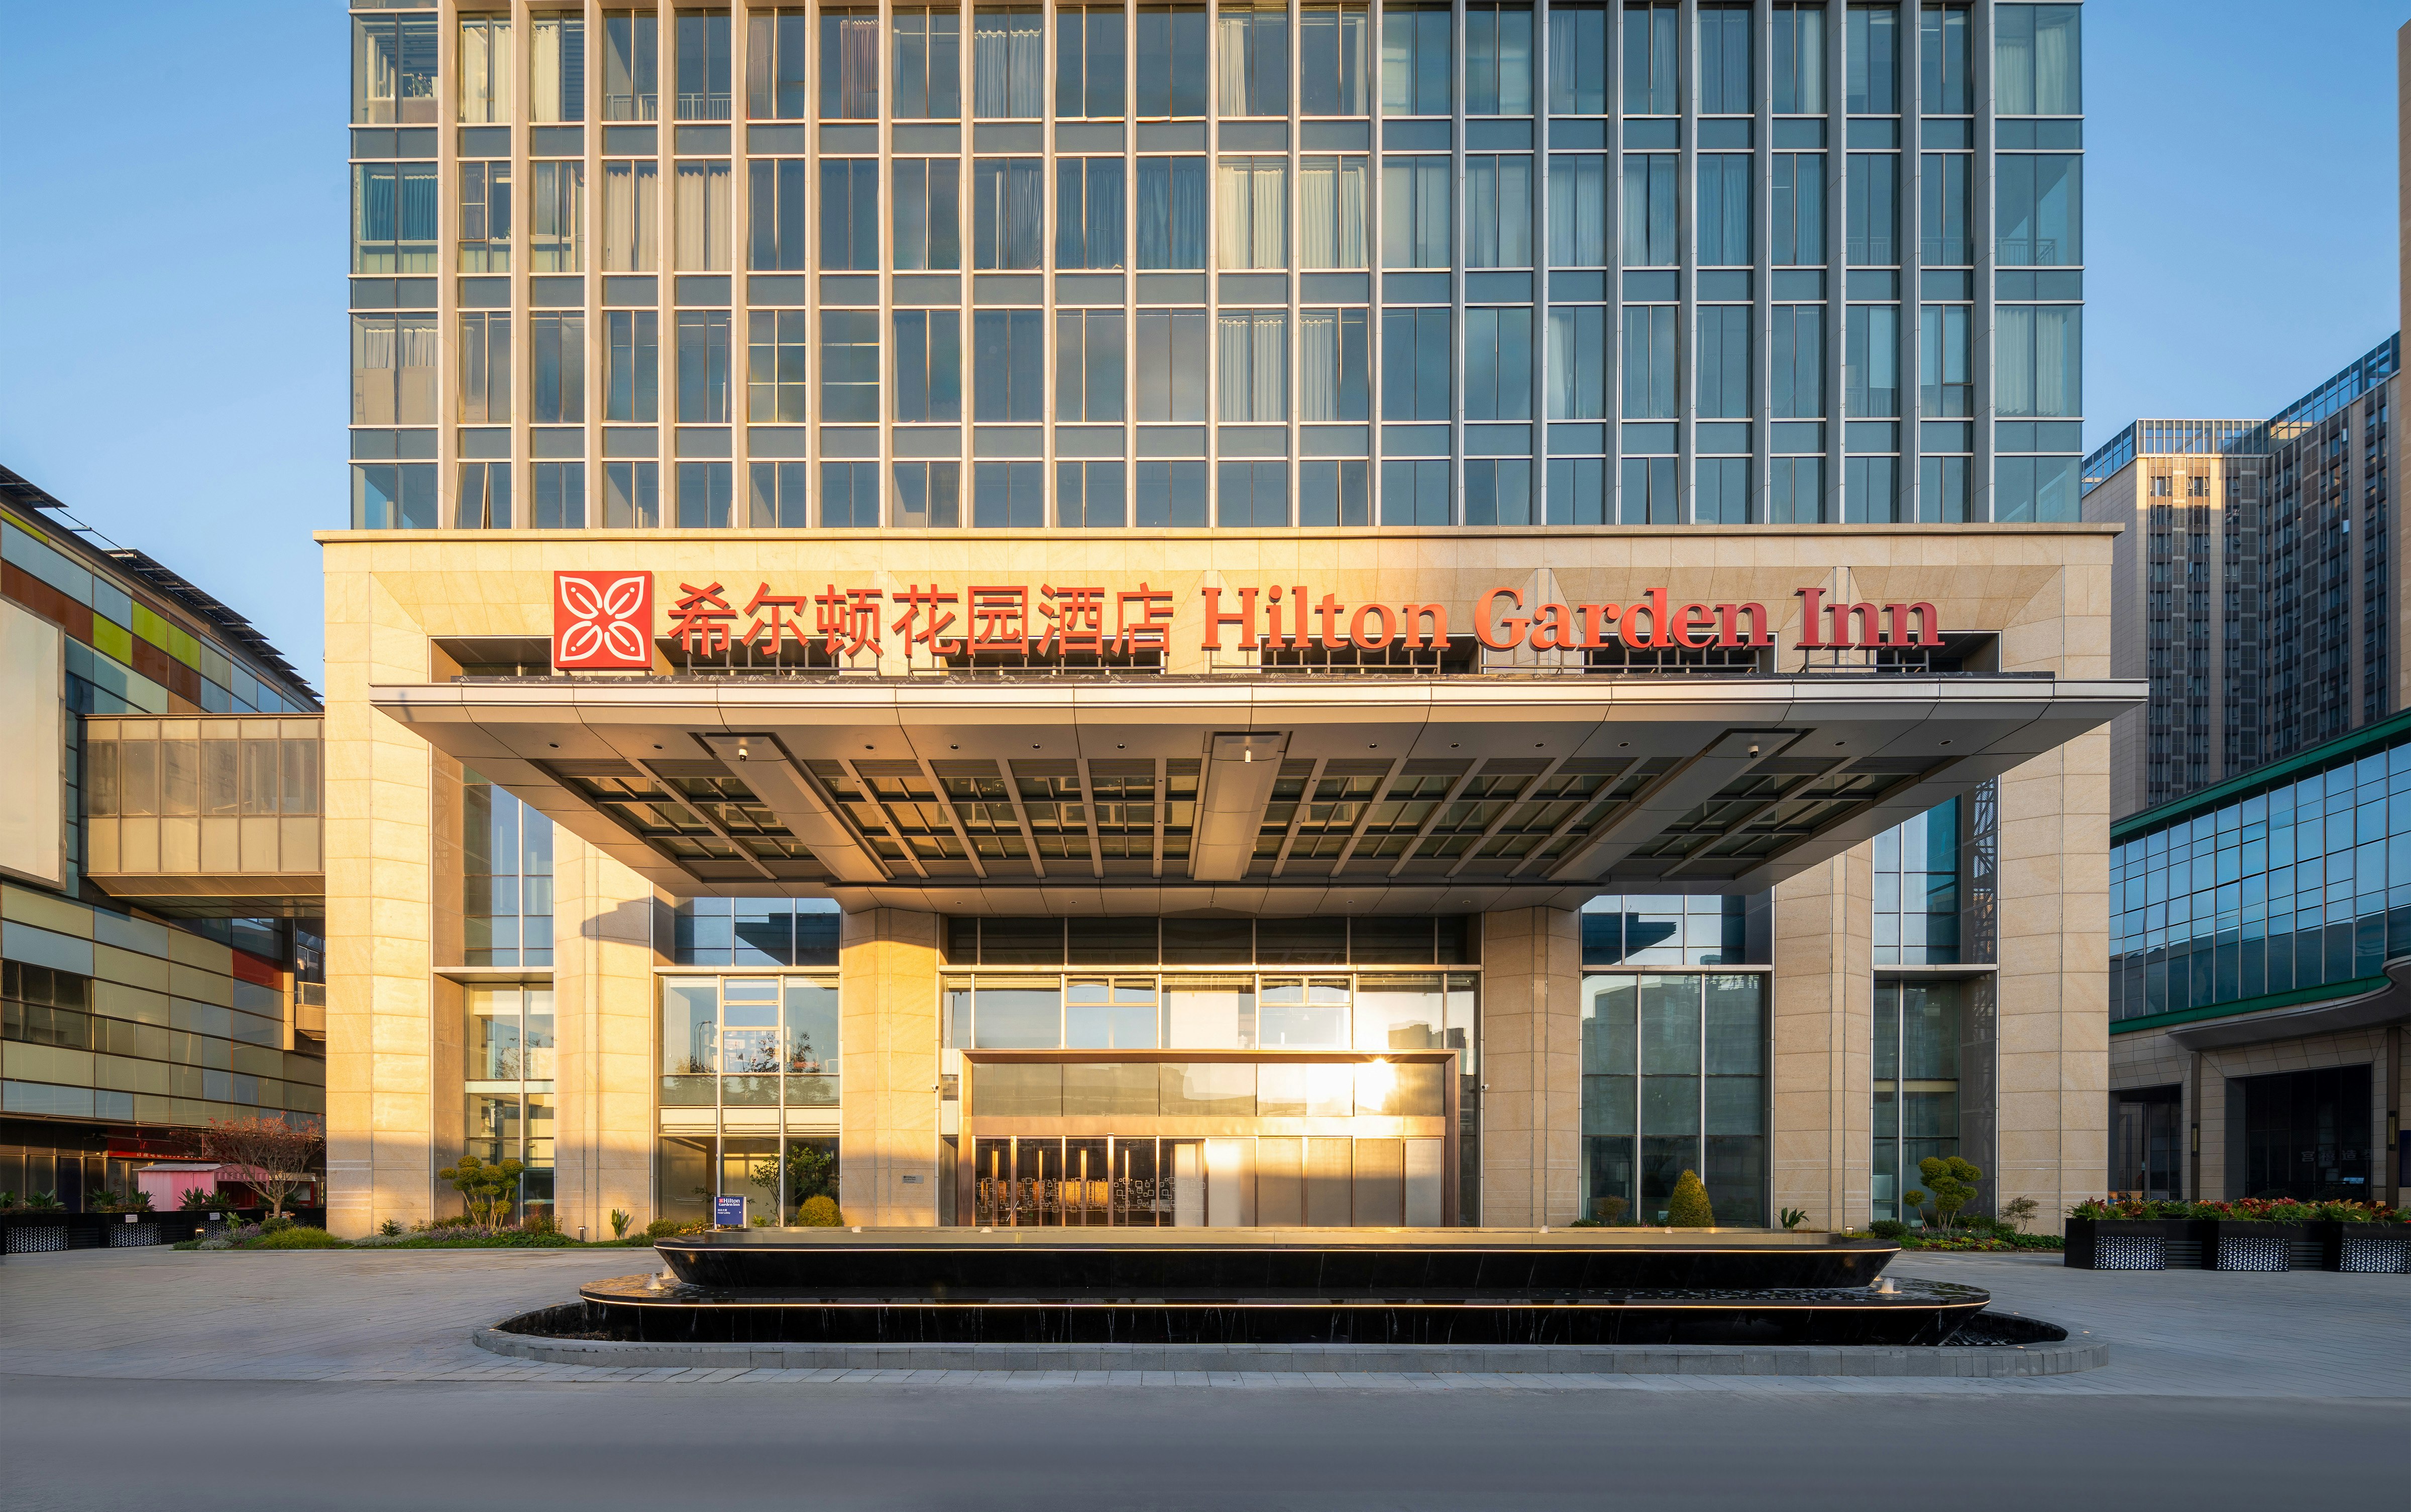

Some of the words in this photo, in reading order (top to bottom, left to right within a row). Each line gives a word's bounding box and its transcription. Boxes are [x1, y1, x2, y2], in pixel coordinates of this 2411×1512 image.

[667, 581, 1174, 659] 希尔顿花园酒店
[1201, 585, 1451, 651] Hilton
[1474, 587, 1775, 650] Garden
[1794, 587, 1946, 649] Inn
